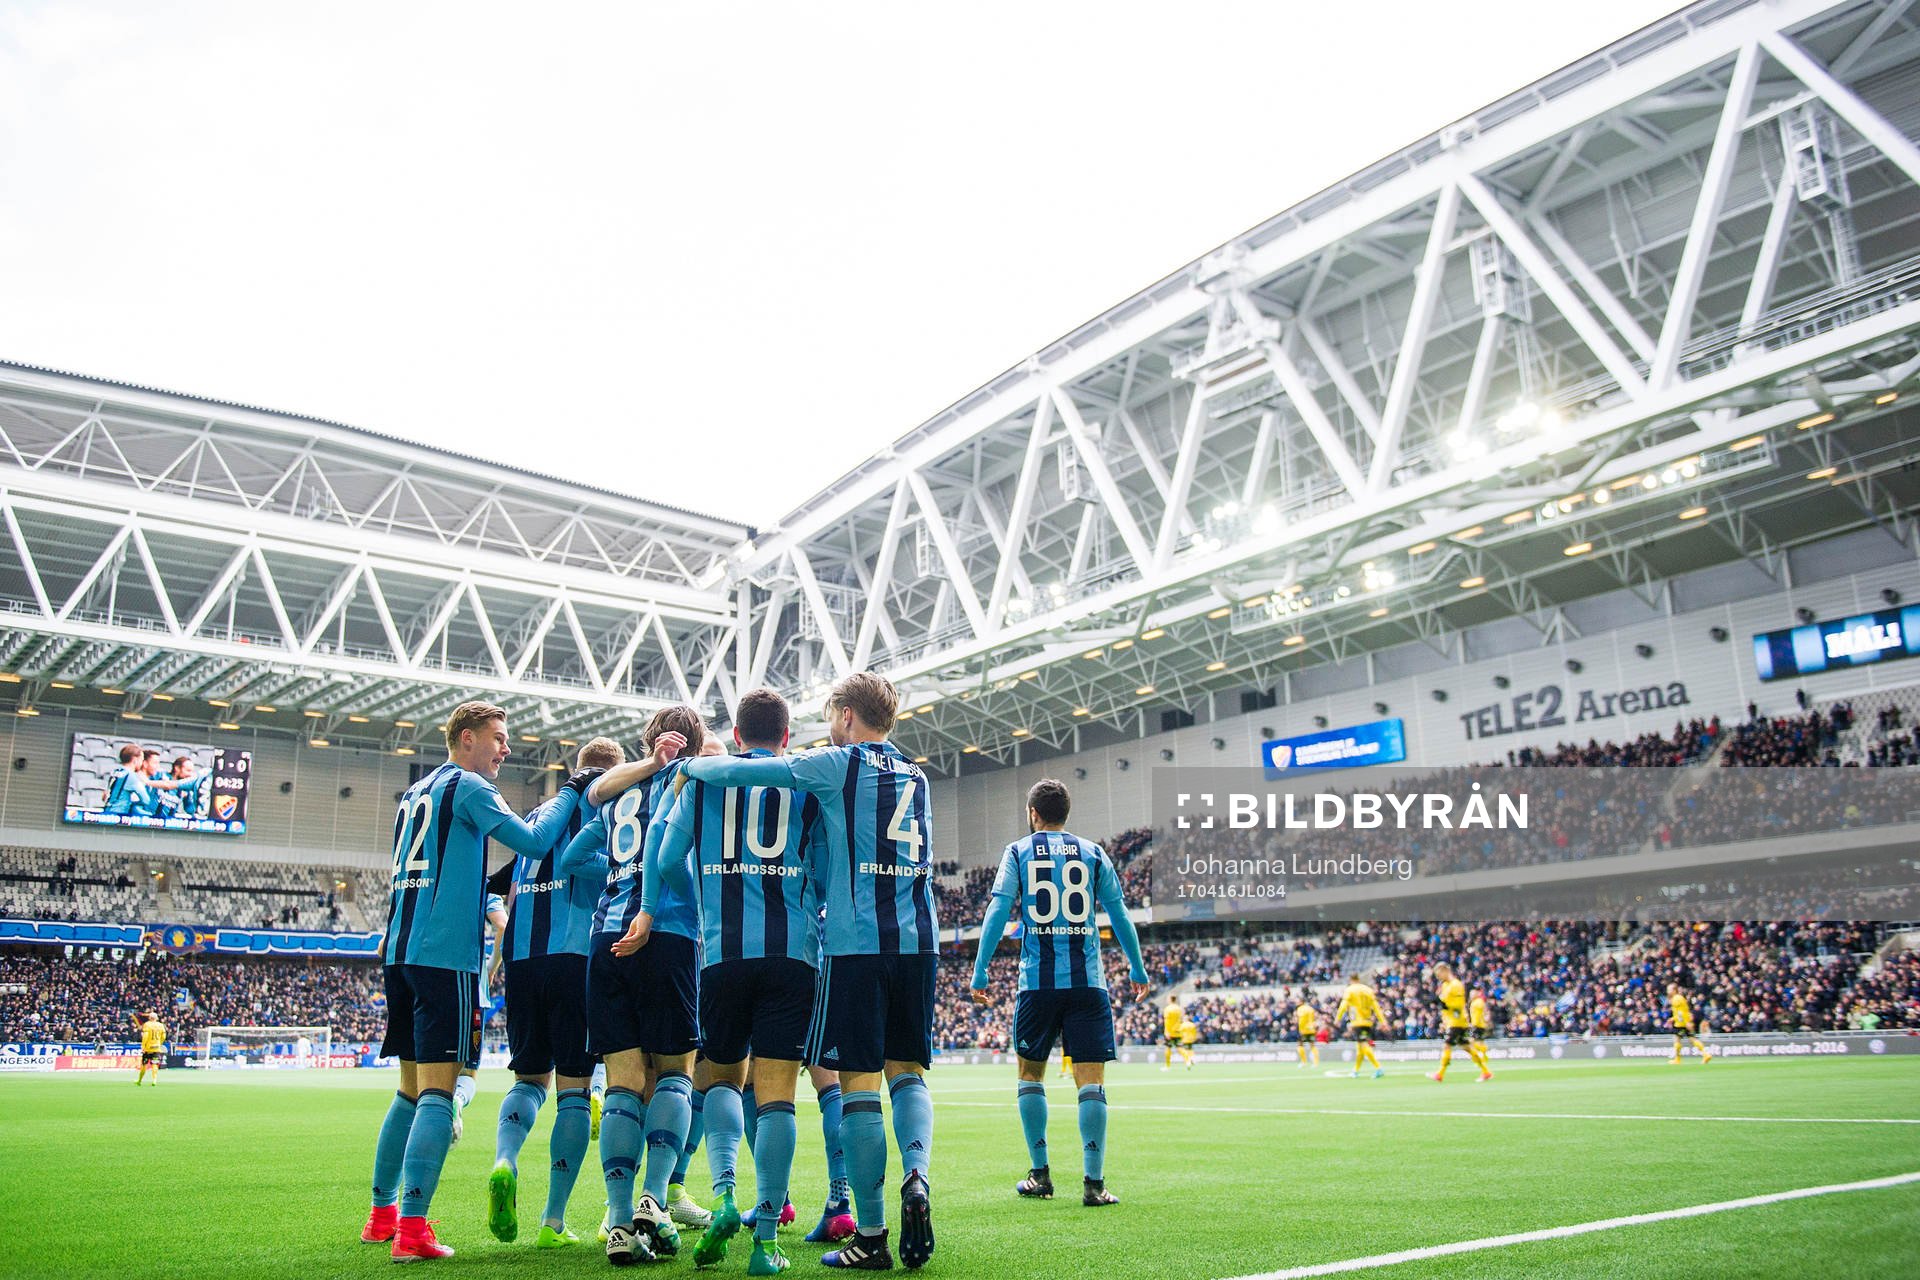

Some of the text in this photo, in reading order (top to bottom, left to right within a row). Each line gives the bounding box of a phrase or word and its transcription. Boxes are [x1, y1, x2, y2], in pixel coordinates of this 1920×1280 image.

[1460, 681, 1691, 740] TELE2 Arena
[236, 759, 247, 773] 0
[391, 793, 433, 877] 22
[612, 788, 643, 863] 8
[723, 786, 792, 859] 10
[887, 780, 924, 863] 4
[1036, 844, 1078, 856] EL KABIR
[703, 863, 800, 877] ERLANDSSON
[1027, 860, 1090, 924] 58
[1621, 1044, 1691, 1058] Volkswagn
[1812, 1041, 1849, 1053] 2016
